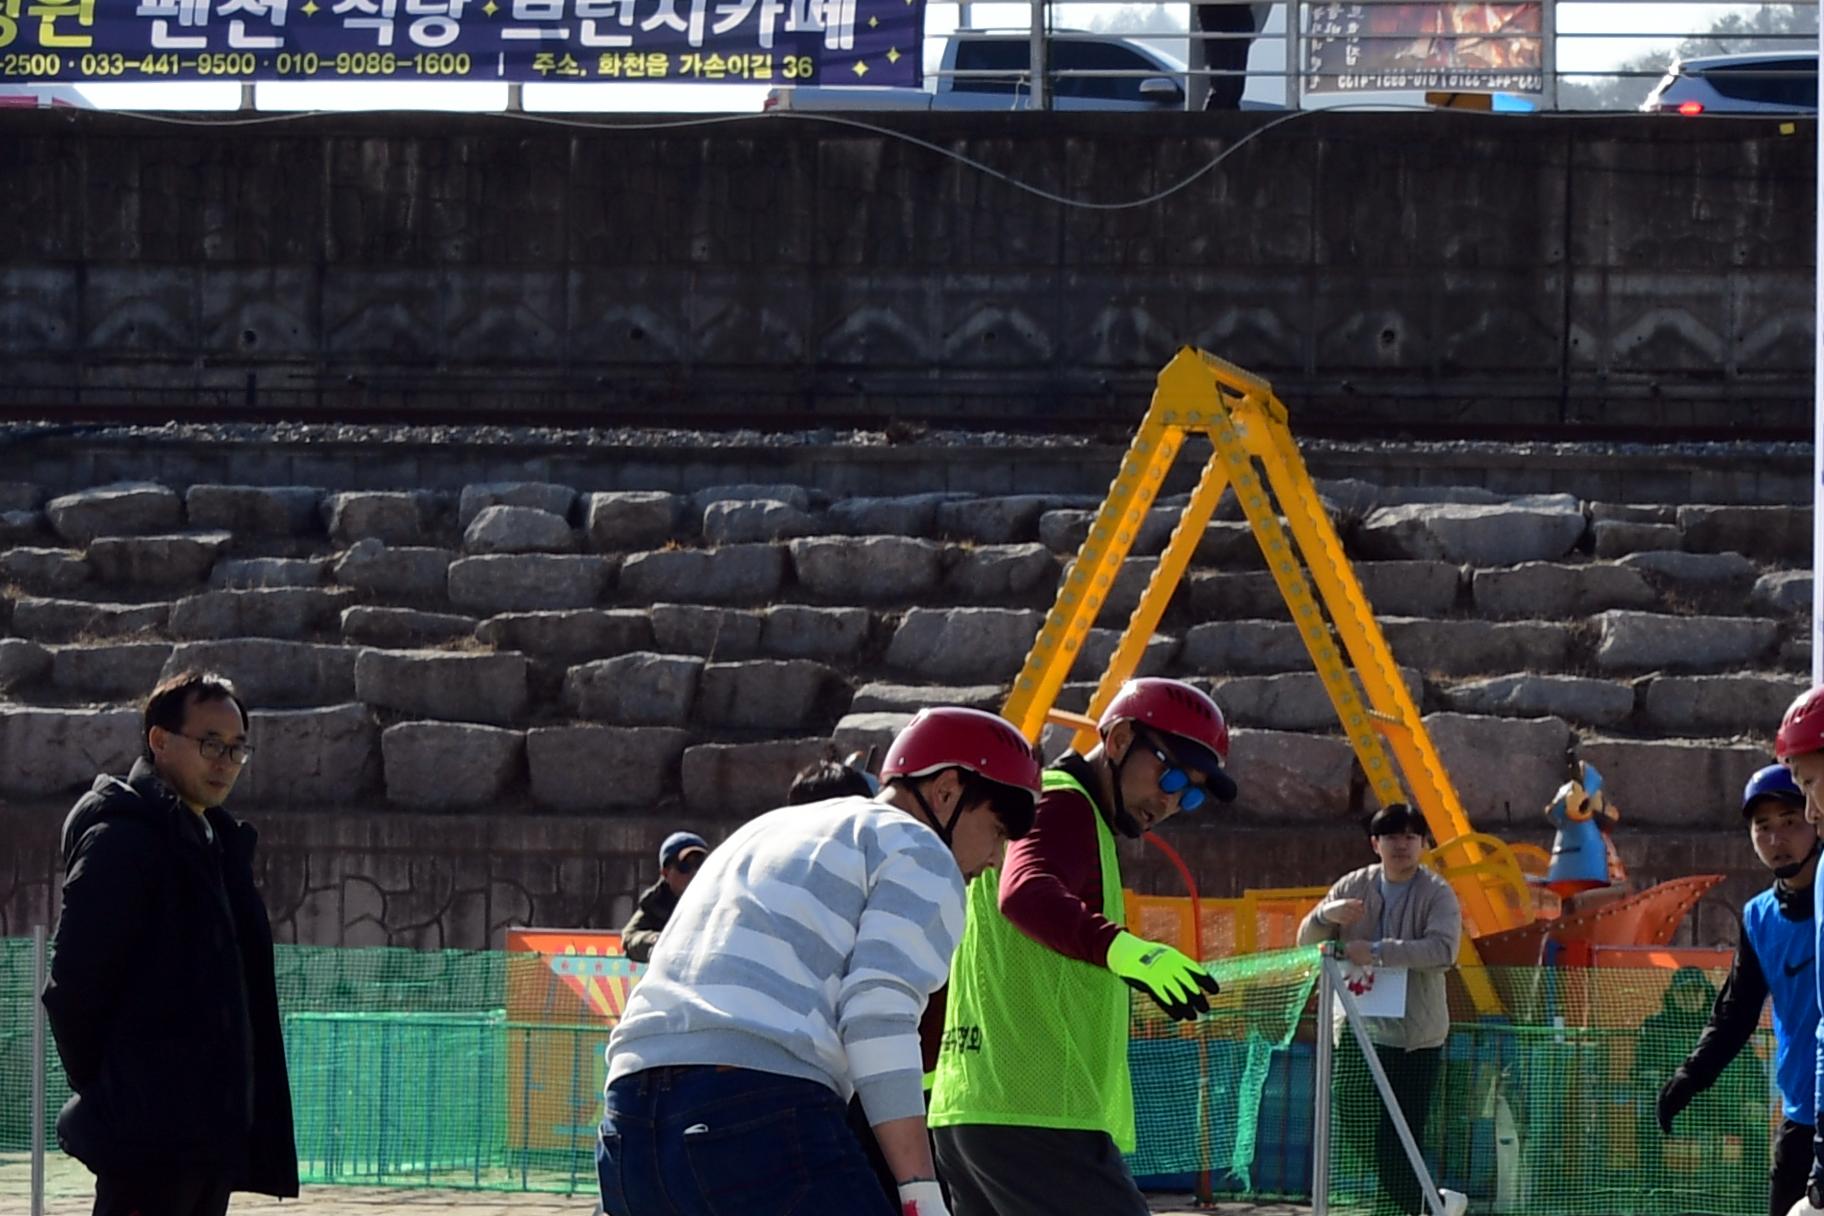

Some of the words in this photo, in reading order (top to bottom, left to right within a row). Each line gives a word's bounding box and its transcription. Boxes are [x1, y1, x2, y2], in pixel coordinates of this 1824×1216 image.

[332, 0, 471, 47] 식당
[81, 53, 256, 76] 033-441-9500
[277, 52, 471, 76] 010-9086-1600
[598, 53, 670, 78] 화천읍
[782, 55, 814, 78] 36
